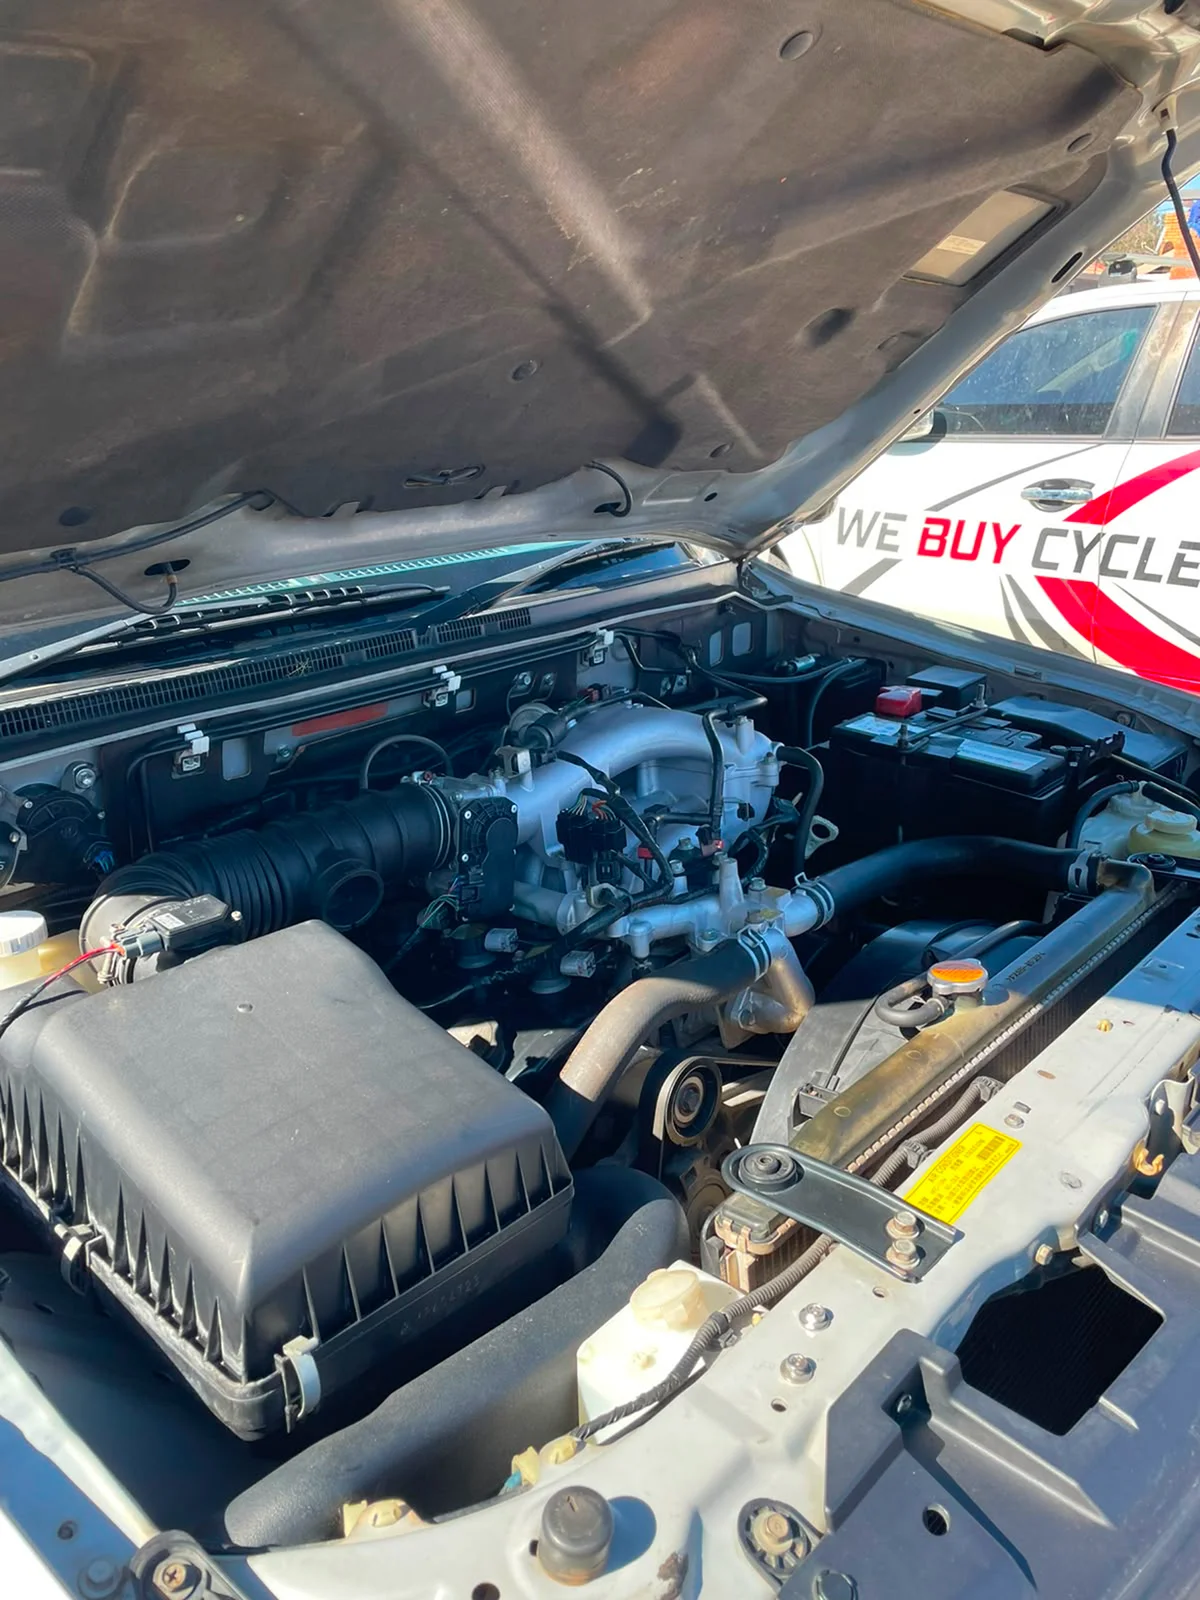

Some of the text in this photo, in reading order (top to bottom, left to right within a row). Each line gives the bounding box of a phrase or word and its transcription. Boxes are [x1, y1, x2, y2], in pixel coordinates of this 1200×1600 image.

[837, 507, 1200, 588] WE BUY CYCLE
